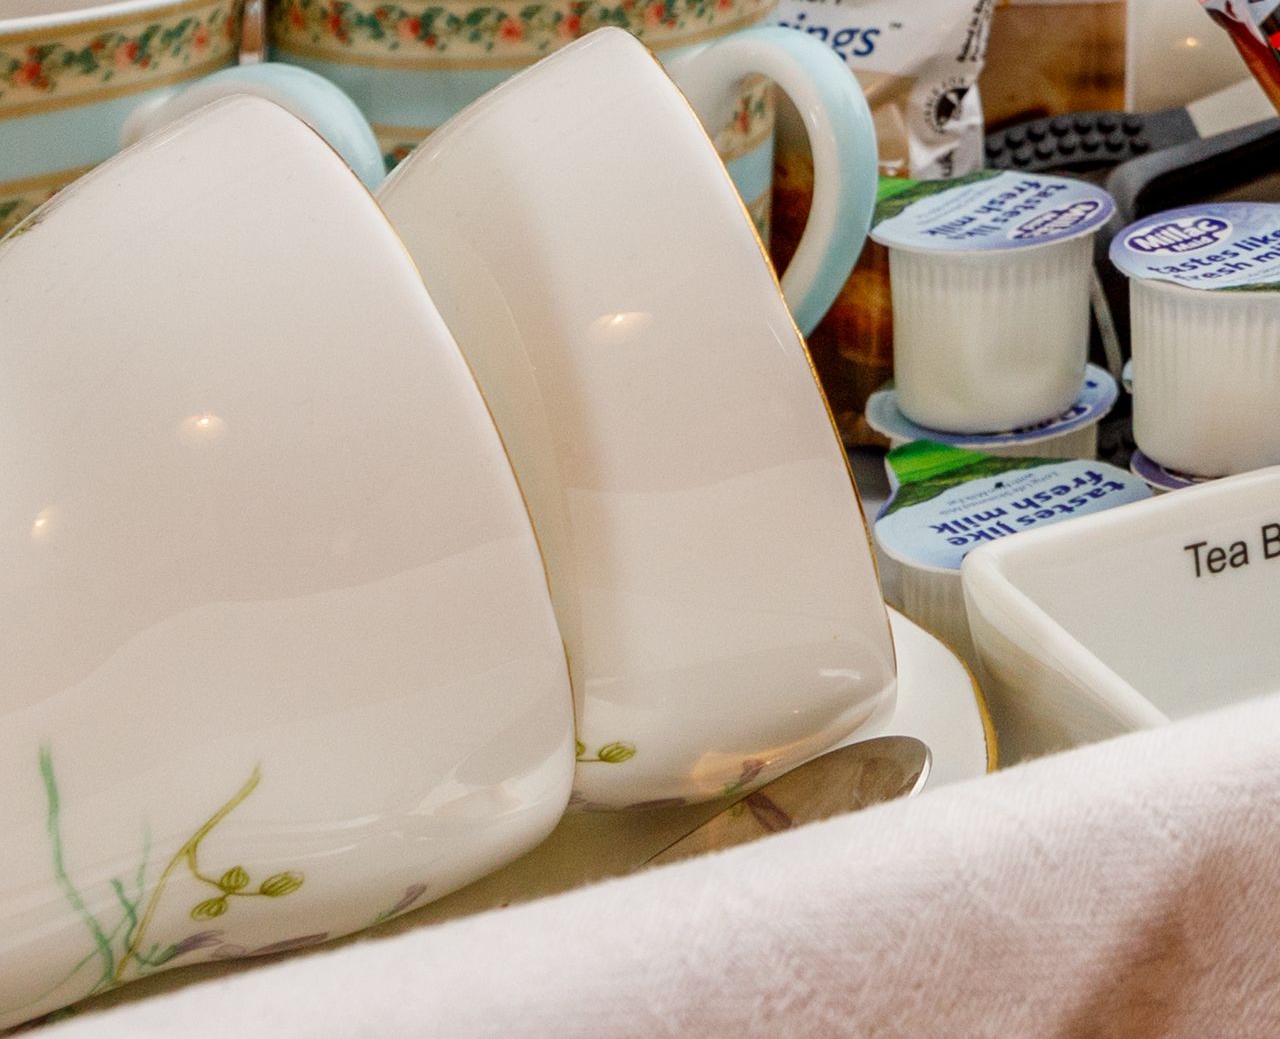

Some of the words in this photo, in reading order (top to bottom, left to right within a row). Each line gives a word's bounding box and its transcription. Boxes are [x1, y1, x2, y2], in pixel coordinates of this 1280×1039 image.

[974, 180, 1042, 215] fresh
[991, 182, 1068, 223] tastes
[922, 216, 977, 237] milk
[1133, 219, 1222, 251] Millac
[1147, 248, 1240, 275] tastes
[1173, 259, 1253, 280] fresh
[1011, 469, 1105, 510] fresh
[1015, 479, 1126, 528] tastes
[927, 506, 1009, 535] milk
[946, 520, 1019, 547] like
[1184, 541, 1249, 578] Tea
